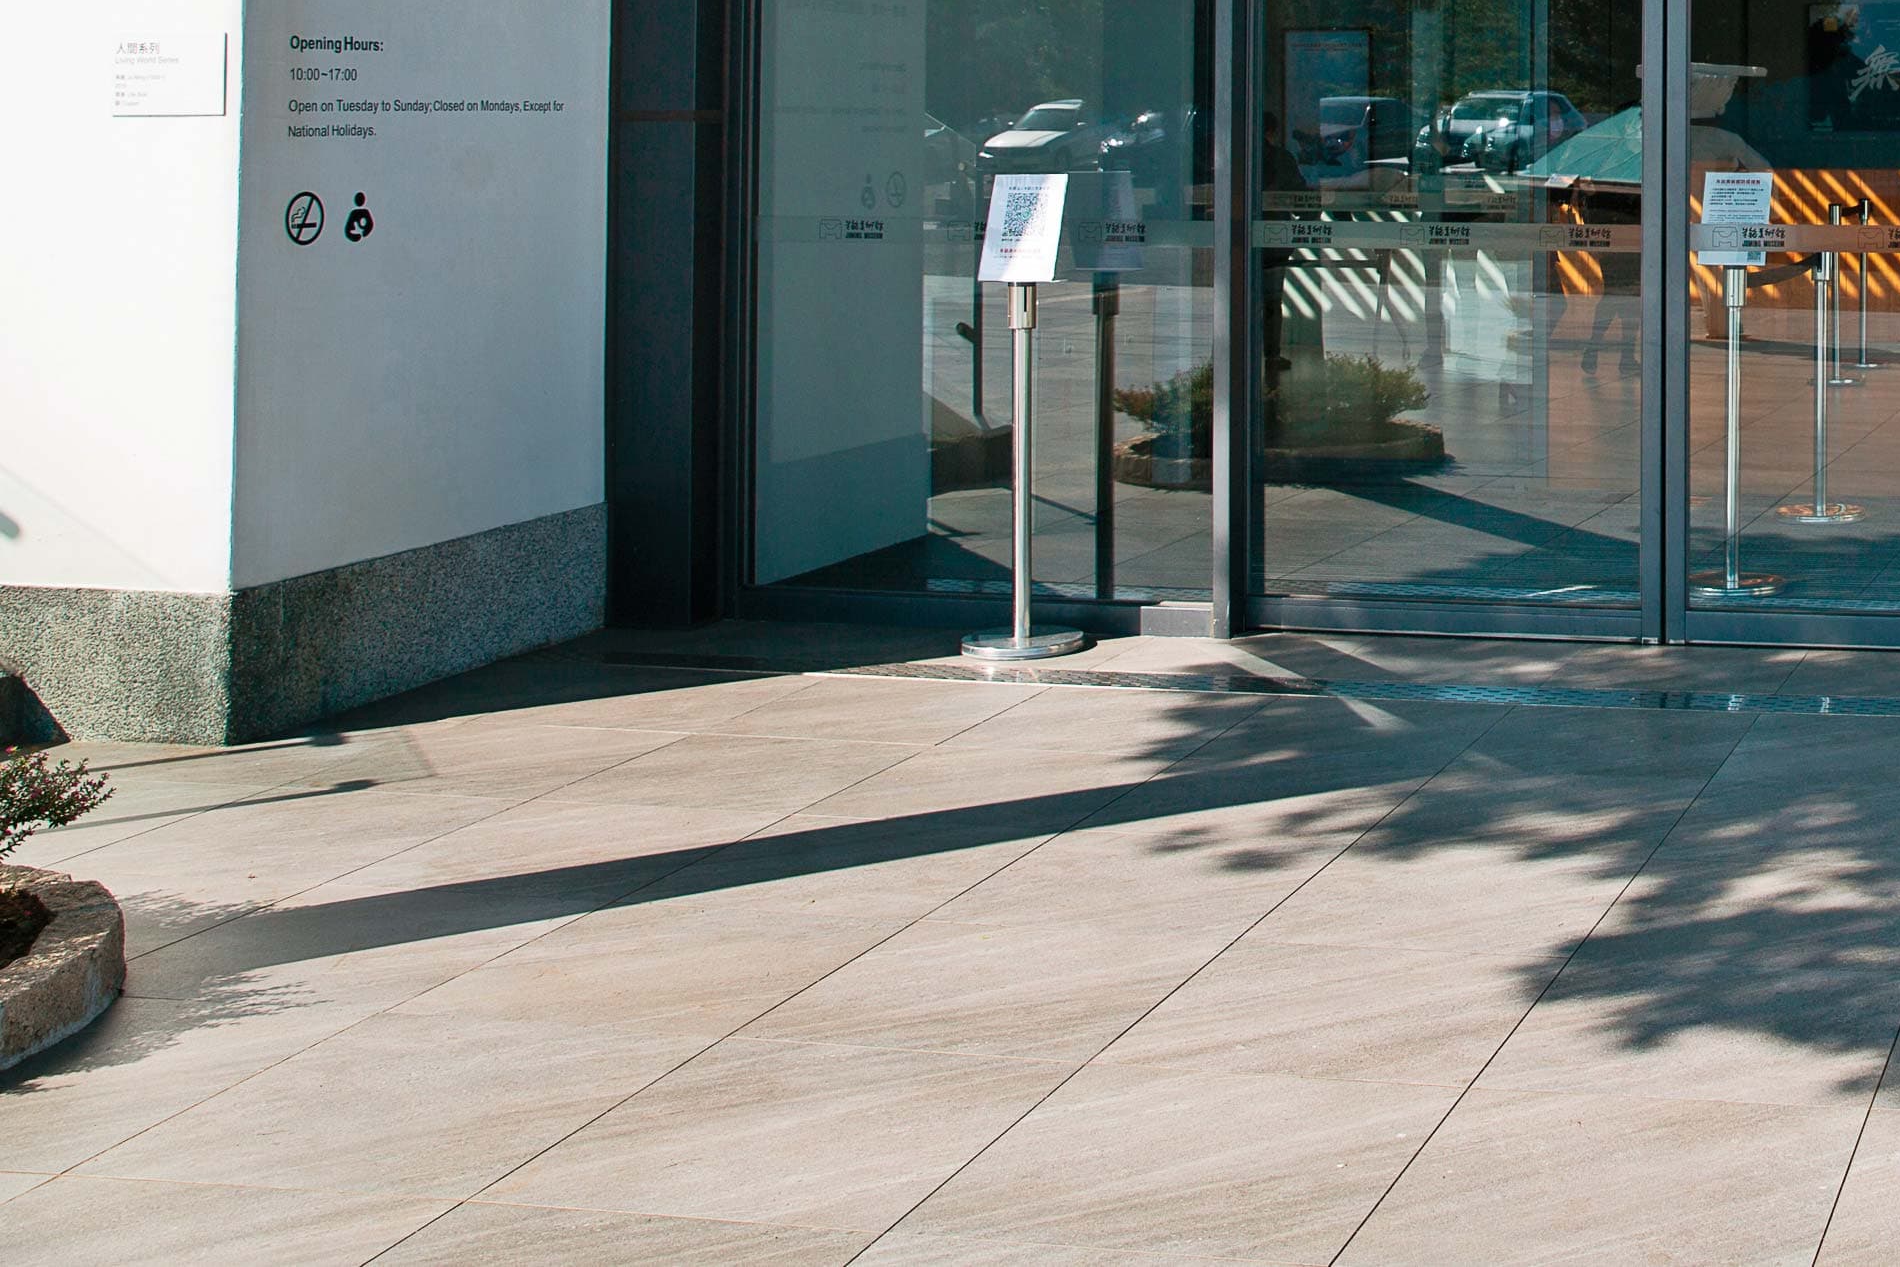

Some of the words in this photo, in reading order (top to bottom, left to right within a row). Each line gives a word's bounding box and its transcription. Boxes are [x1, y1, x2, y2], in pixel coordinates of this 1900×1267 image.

[290, 35, 343, 54] Opening
[344, 36, 384, 52] Hours:
[290, 68, 358, 82] 10:00~17:00
[288, 99, 318, 115] Open
[320, 101, 334, 113] on
[336, 99, 379, 115] Tuesday
[381, 100, 391, 113] to
[433, 100, 465, 112] Closed
[466, 102, 479, 112] on
[480, 100, 522, 114] Mondays,
[523, 100, 551, 114] Except
[553, 100, 565, 112] for
[288, 125, 330, 138] National
[331, 124, 377, 139] Holidays.
